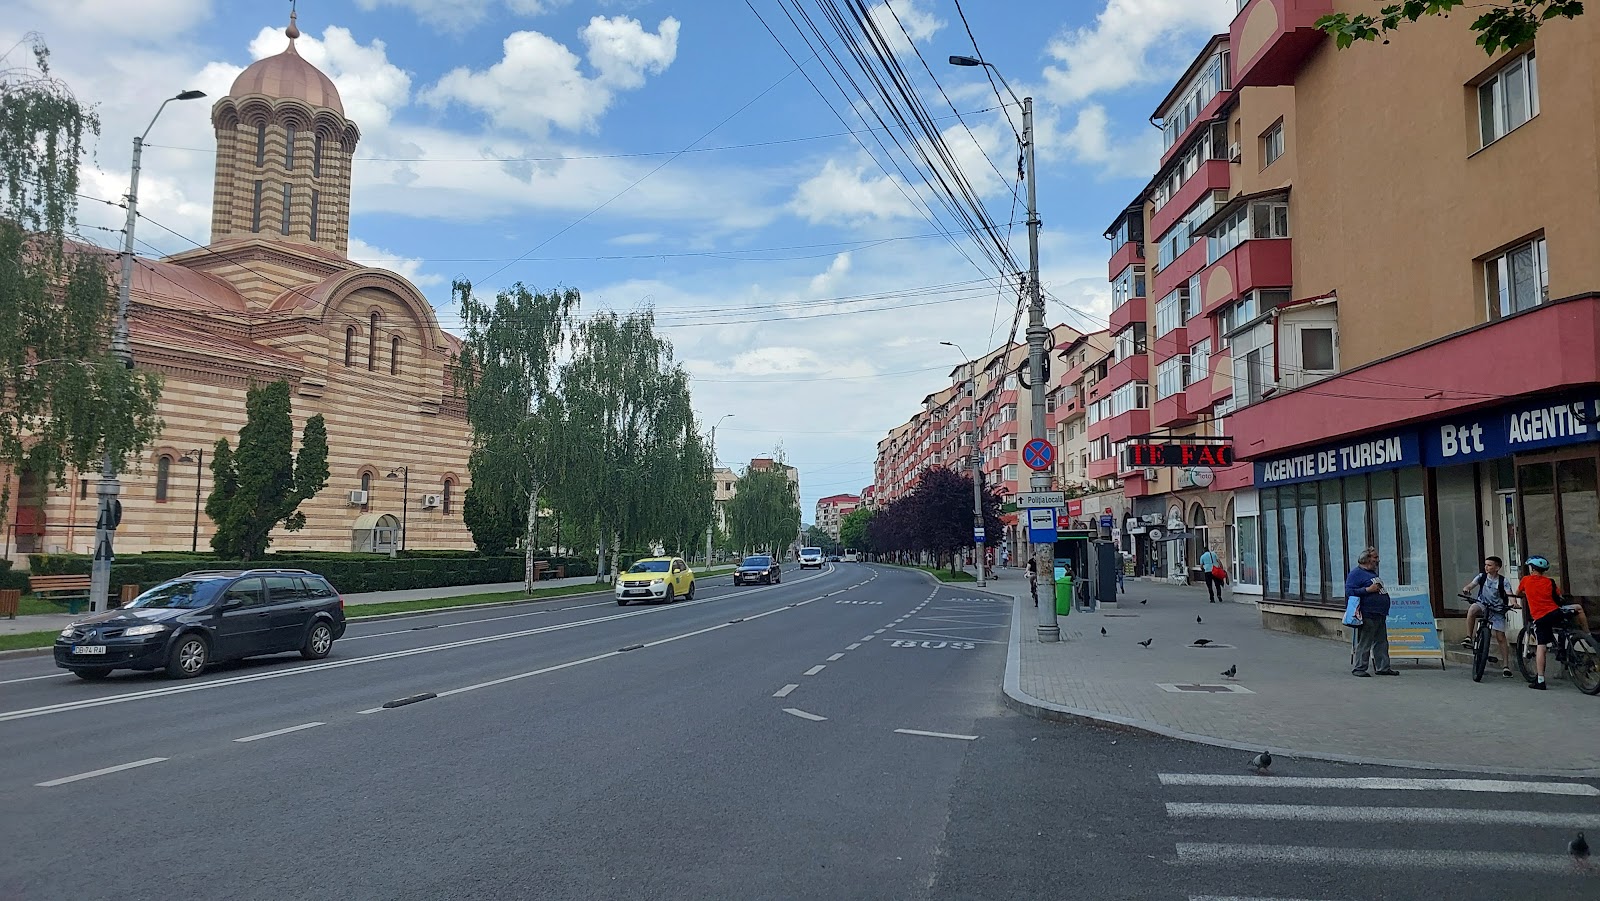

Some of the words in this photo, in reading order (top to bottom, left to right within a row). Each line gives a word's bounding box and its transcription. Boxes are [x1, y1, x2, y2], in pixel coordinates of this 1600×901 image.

[1440, 422, 1485, 457] Btt
[1509, 401, 1588, 444] AGENTIE
[1263, 456, 1315, 483] AGENTIE
[1317, 450, 1337, 475] DE
[1340, 436, 1403, 471] TURISM
[1046, 495, 1063, 504] Locală
[890, 640, 976, 650] BUS
